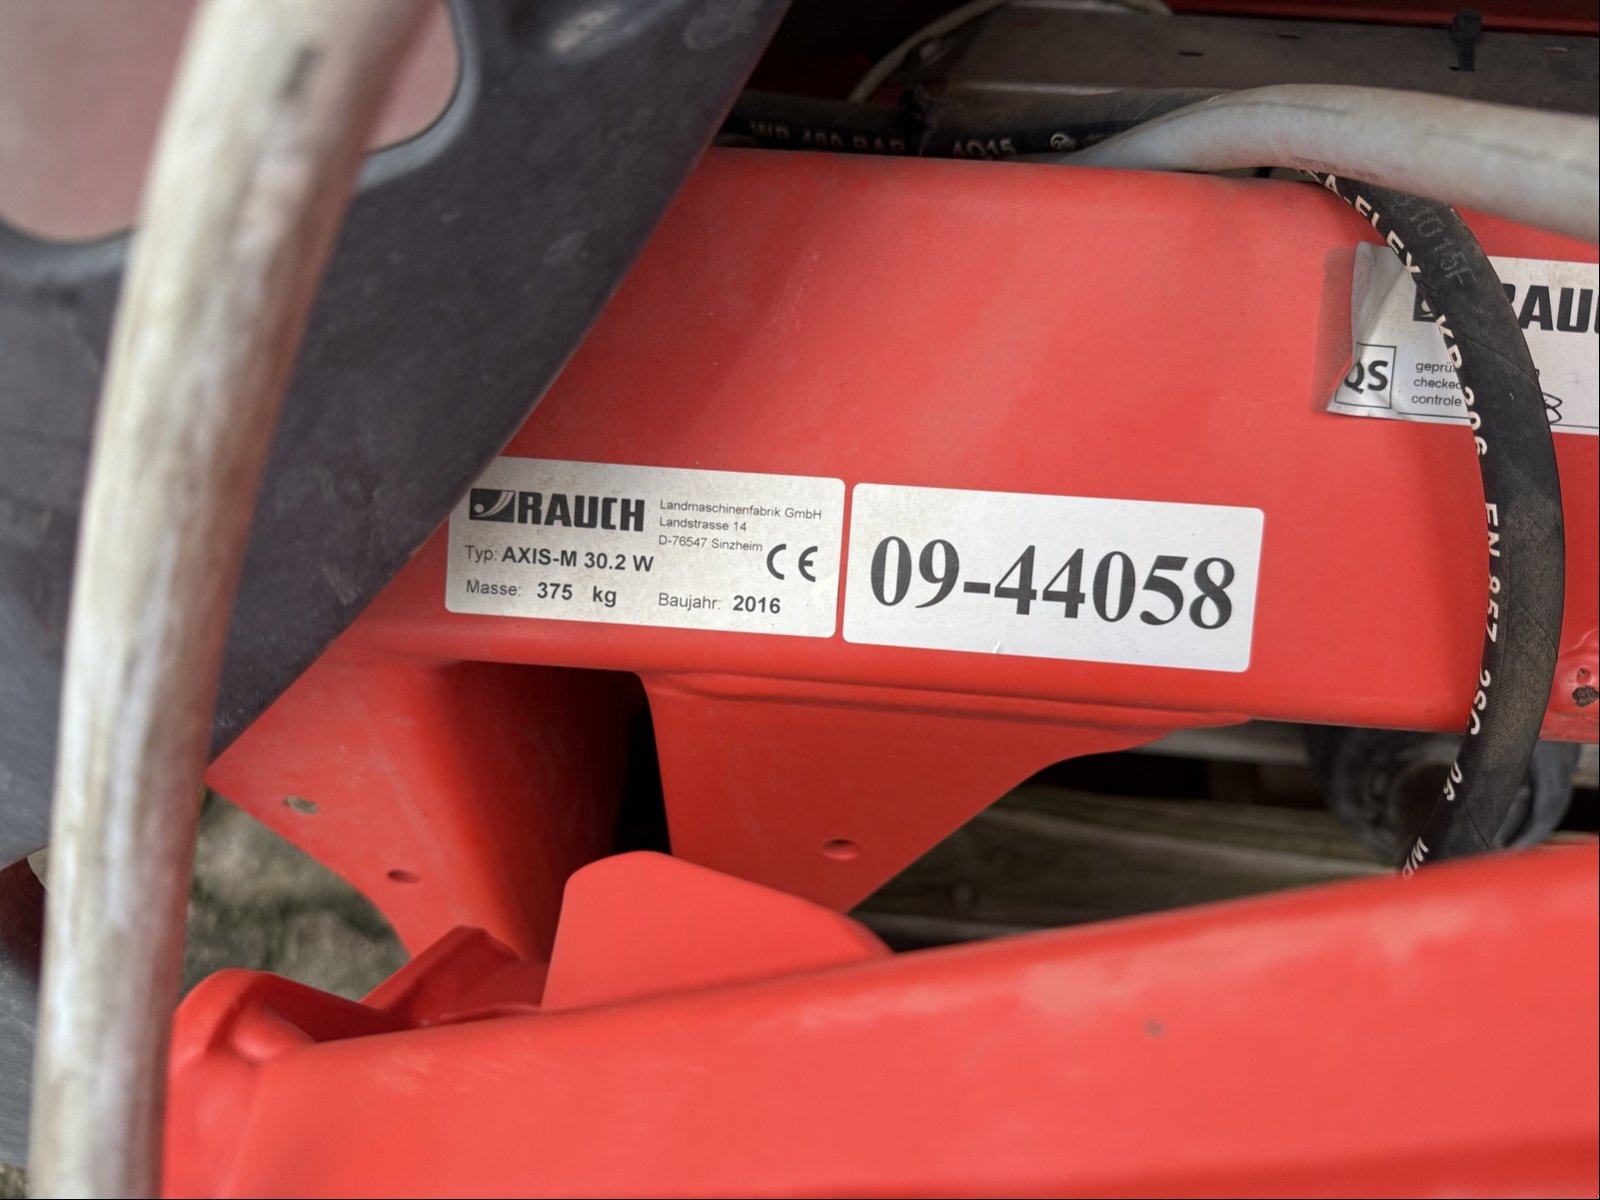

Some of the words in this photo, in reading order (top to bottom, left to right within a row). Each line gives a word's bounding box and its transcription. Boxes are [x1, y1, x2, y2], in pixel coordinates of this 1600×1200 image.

[1501, 282, 1599, 334] AU
[1343, 359, 1389, 394] QS
[1415, 361, 1456, 374] geprü
[517, 491, 645, 532] RAUCH
[659, 499, 781, 518] Landmaschinenfabrik
[784, 507, 822, 520] GmbH
[659, 517, 729, 532] Landstrasse
[733, 521, 747, 532] 14
[1485, 502, 1500, 557] EN
[658, 534, 708, 549] D-76547
[711, 537, 763, 552] Sinzheim
[465, 544, 497, 564] Typ:
[502, 546, 577, 568] AXIS-M
[584, 552, 626, 571] 30.2
[633, 555, 654, 573] W
[465, 580, 521, 598] Masse:
[536, 581, 573, 600] 375
[592, 585, 617, 608] kg
[869, 535, 1236, 630] 09-44058
[658, 592, 721, 613] Baujahr:
[732, 594, 781, 614] 2016
[1487, 576, 1501, 643] 857
